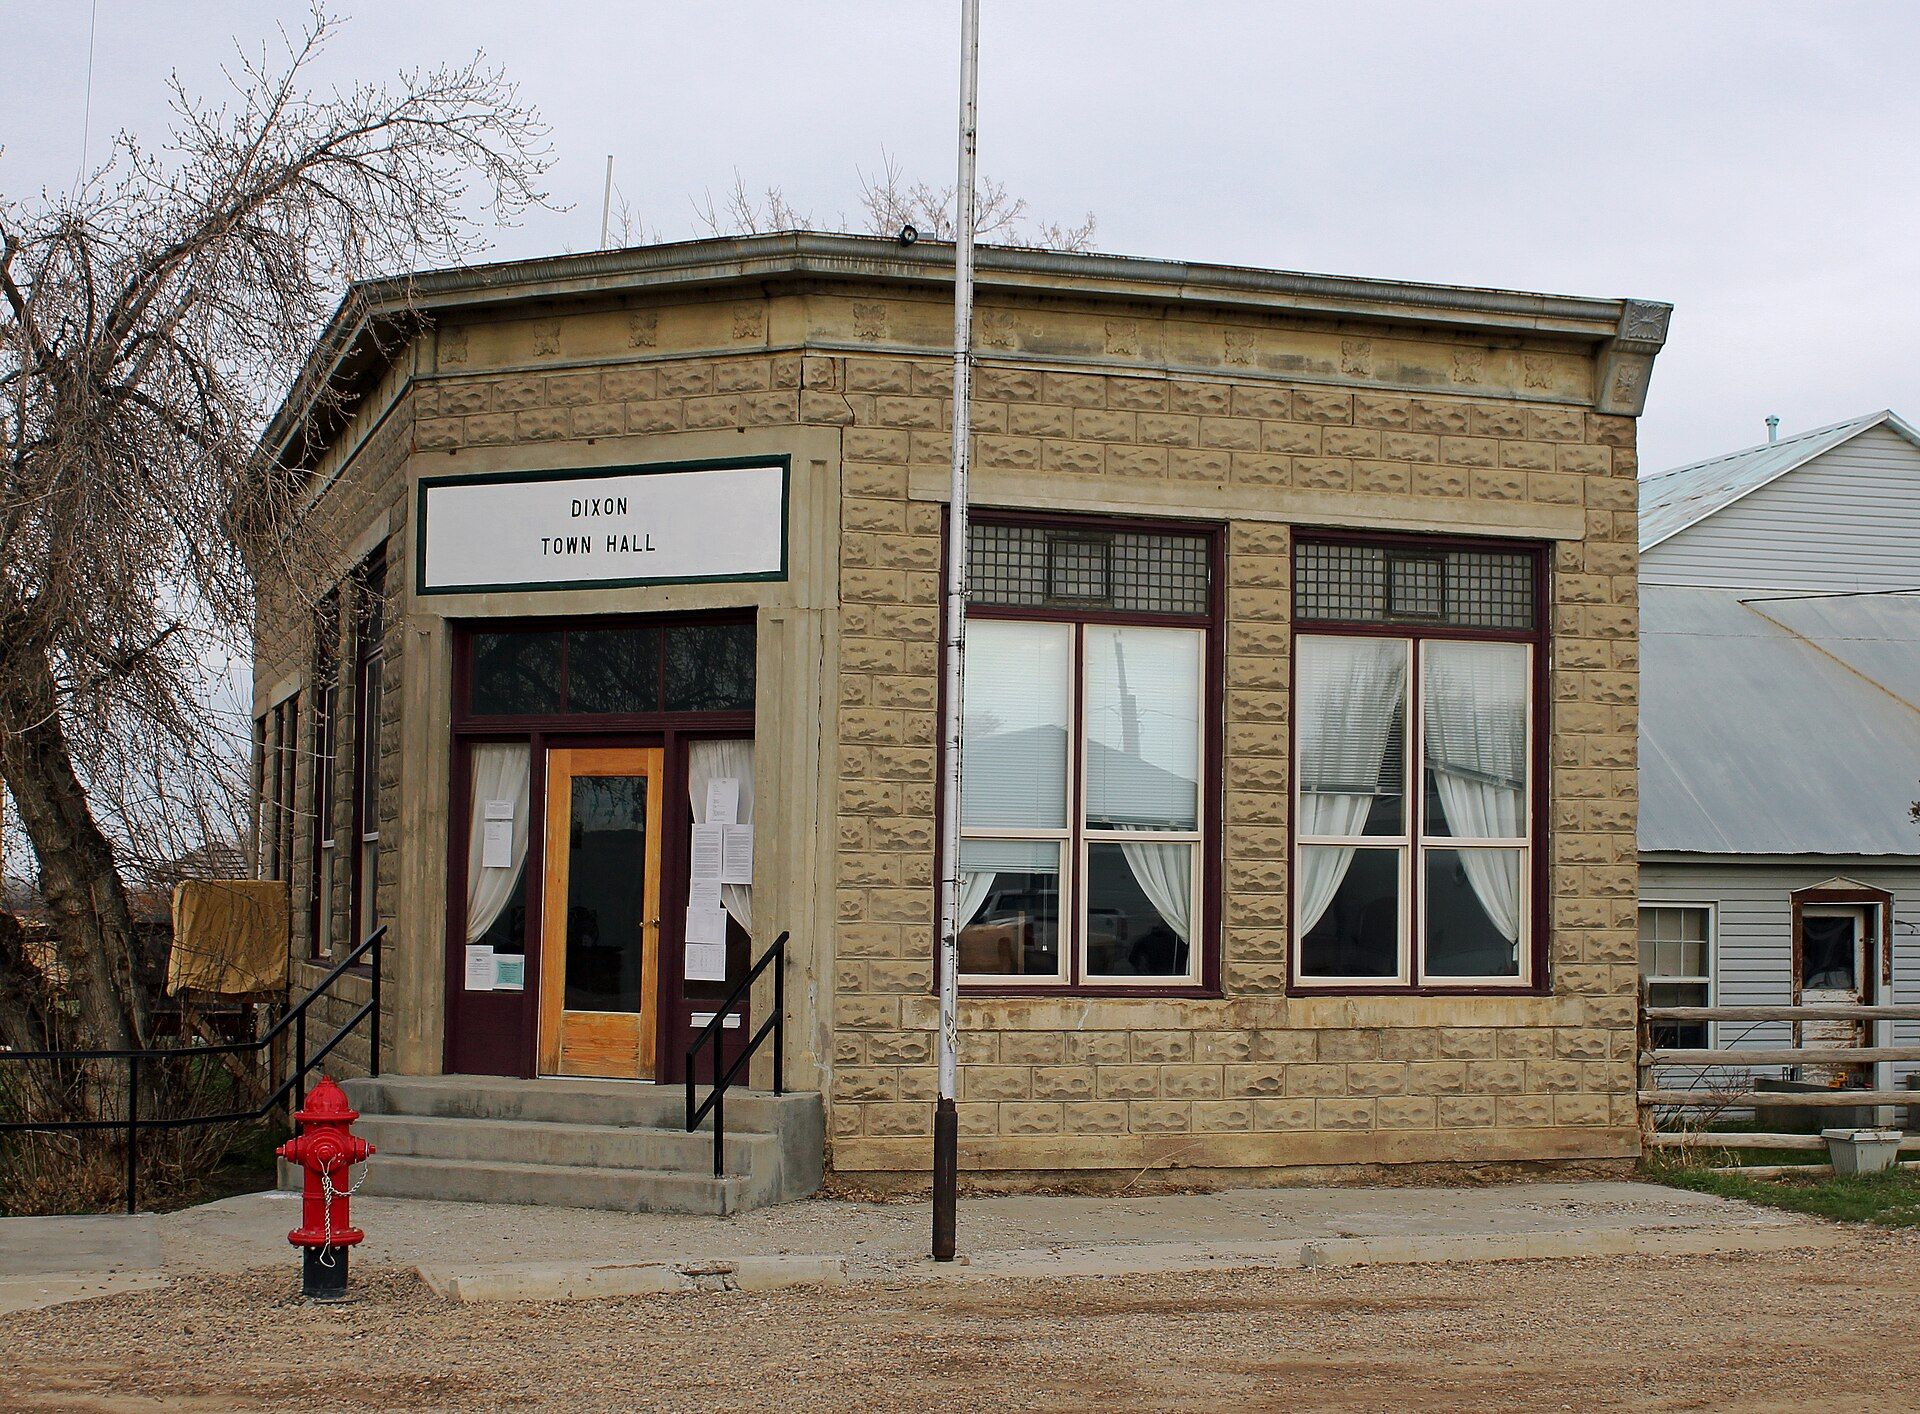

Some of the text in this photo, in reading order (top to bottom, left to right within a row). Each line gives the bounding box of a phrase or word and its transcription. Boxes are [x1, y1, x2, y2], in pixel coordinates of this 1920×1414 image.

[571, 497, 627, 518] DIXON
[541, 534, 656, 555] TOWN HALL
